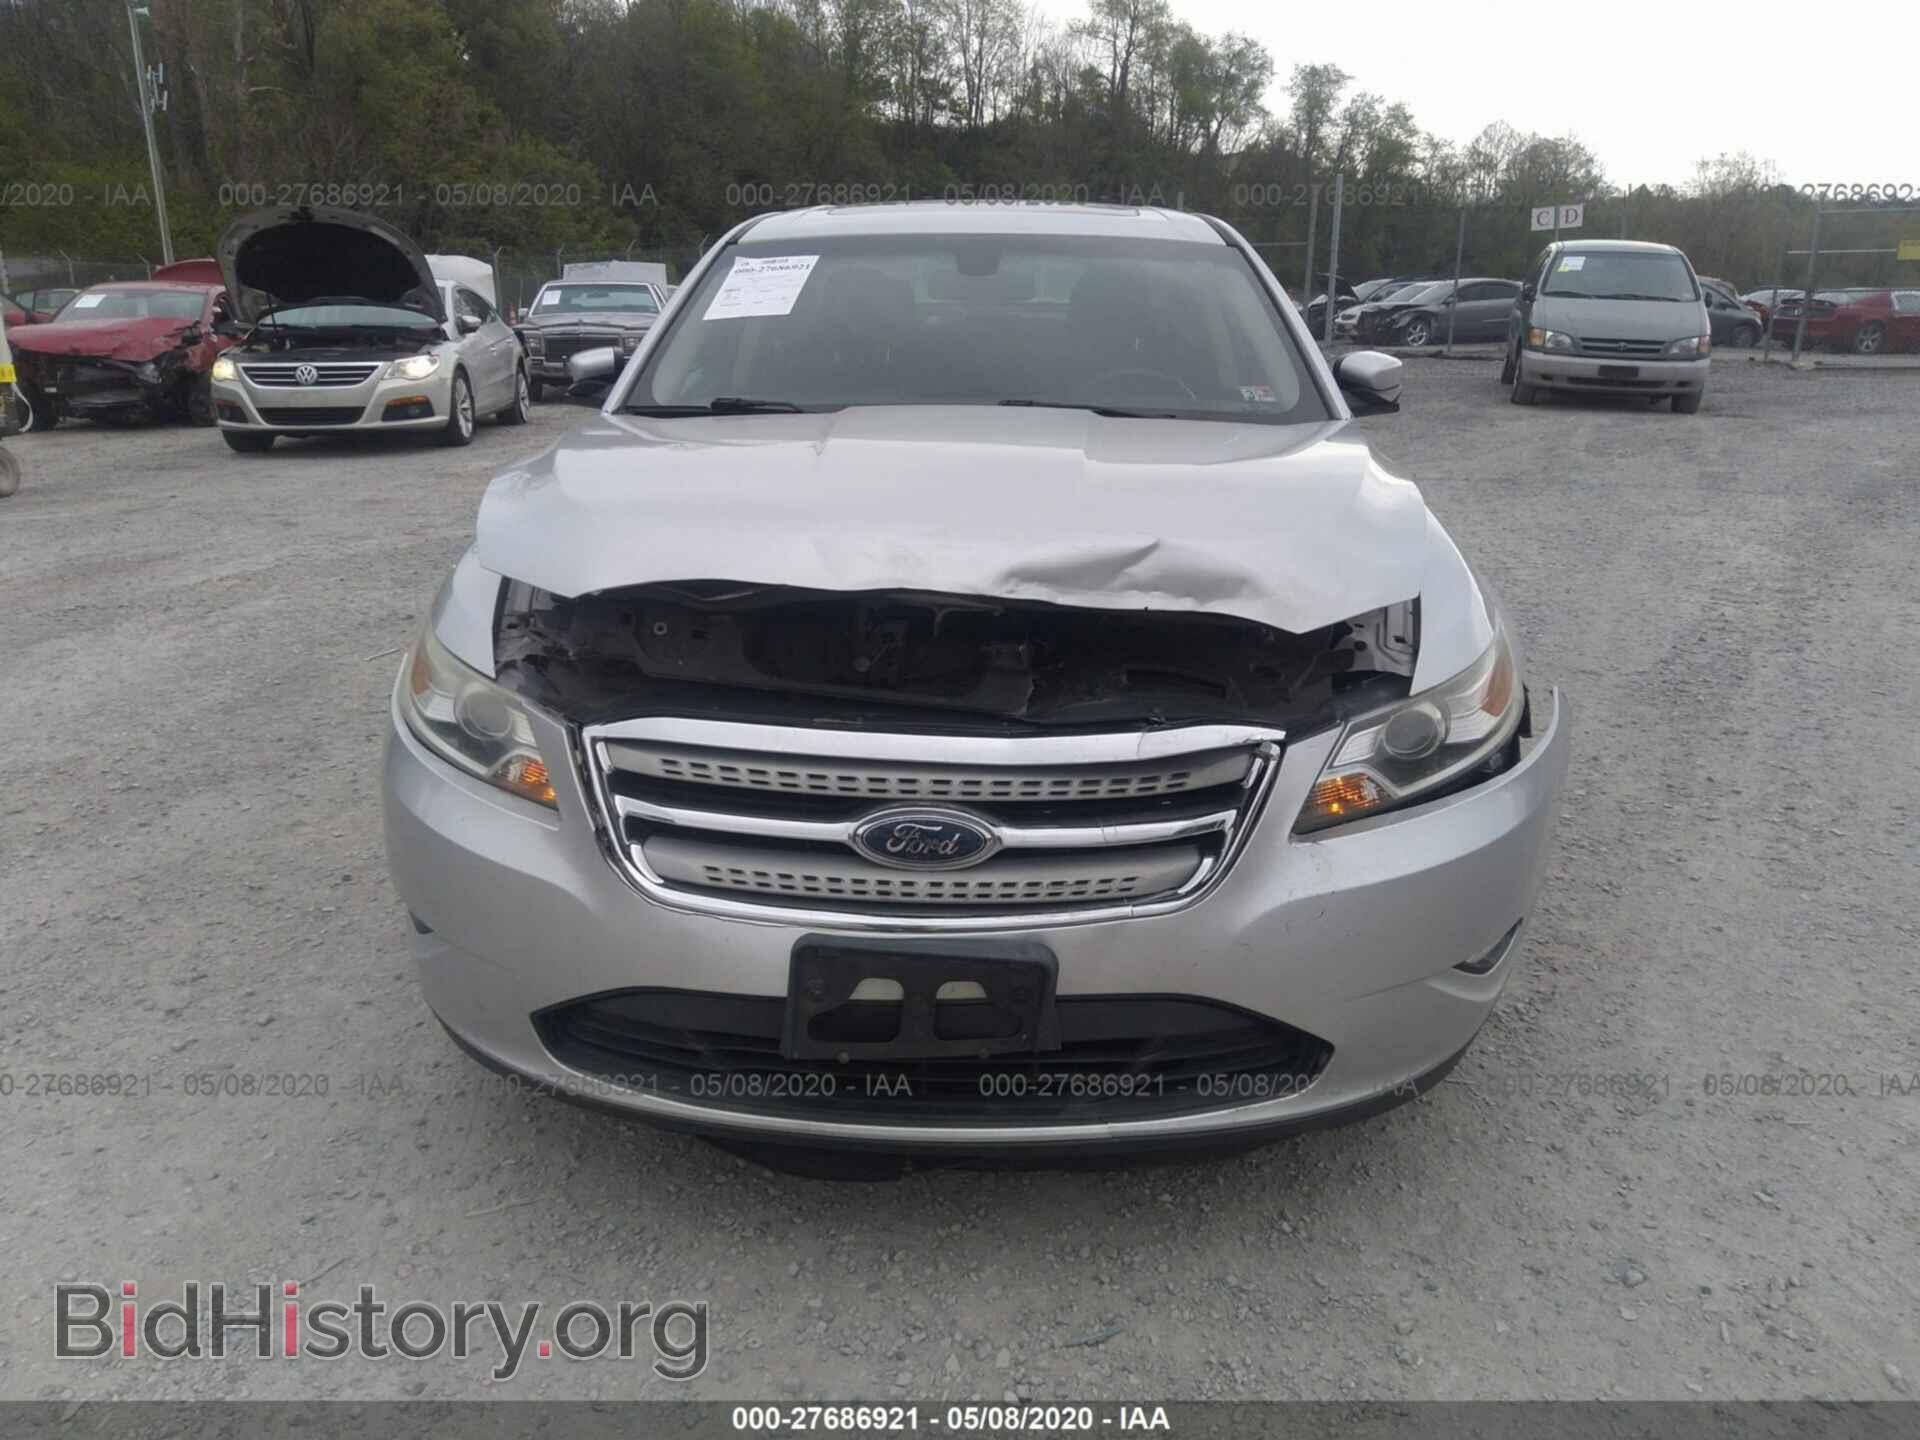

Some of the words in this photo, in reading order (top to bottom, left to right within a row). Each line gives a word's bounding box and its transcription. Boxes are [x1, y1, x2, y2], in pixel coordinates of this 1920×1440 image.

[1536, 210, 1550, 226] C
[1564, 208, 1578, 224] D
[886, 822, 961, 855] Ford
